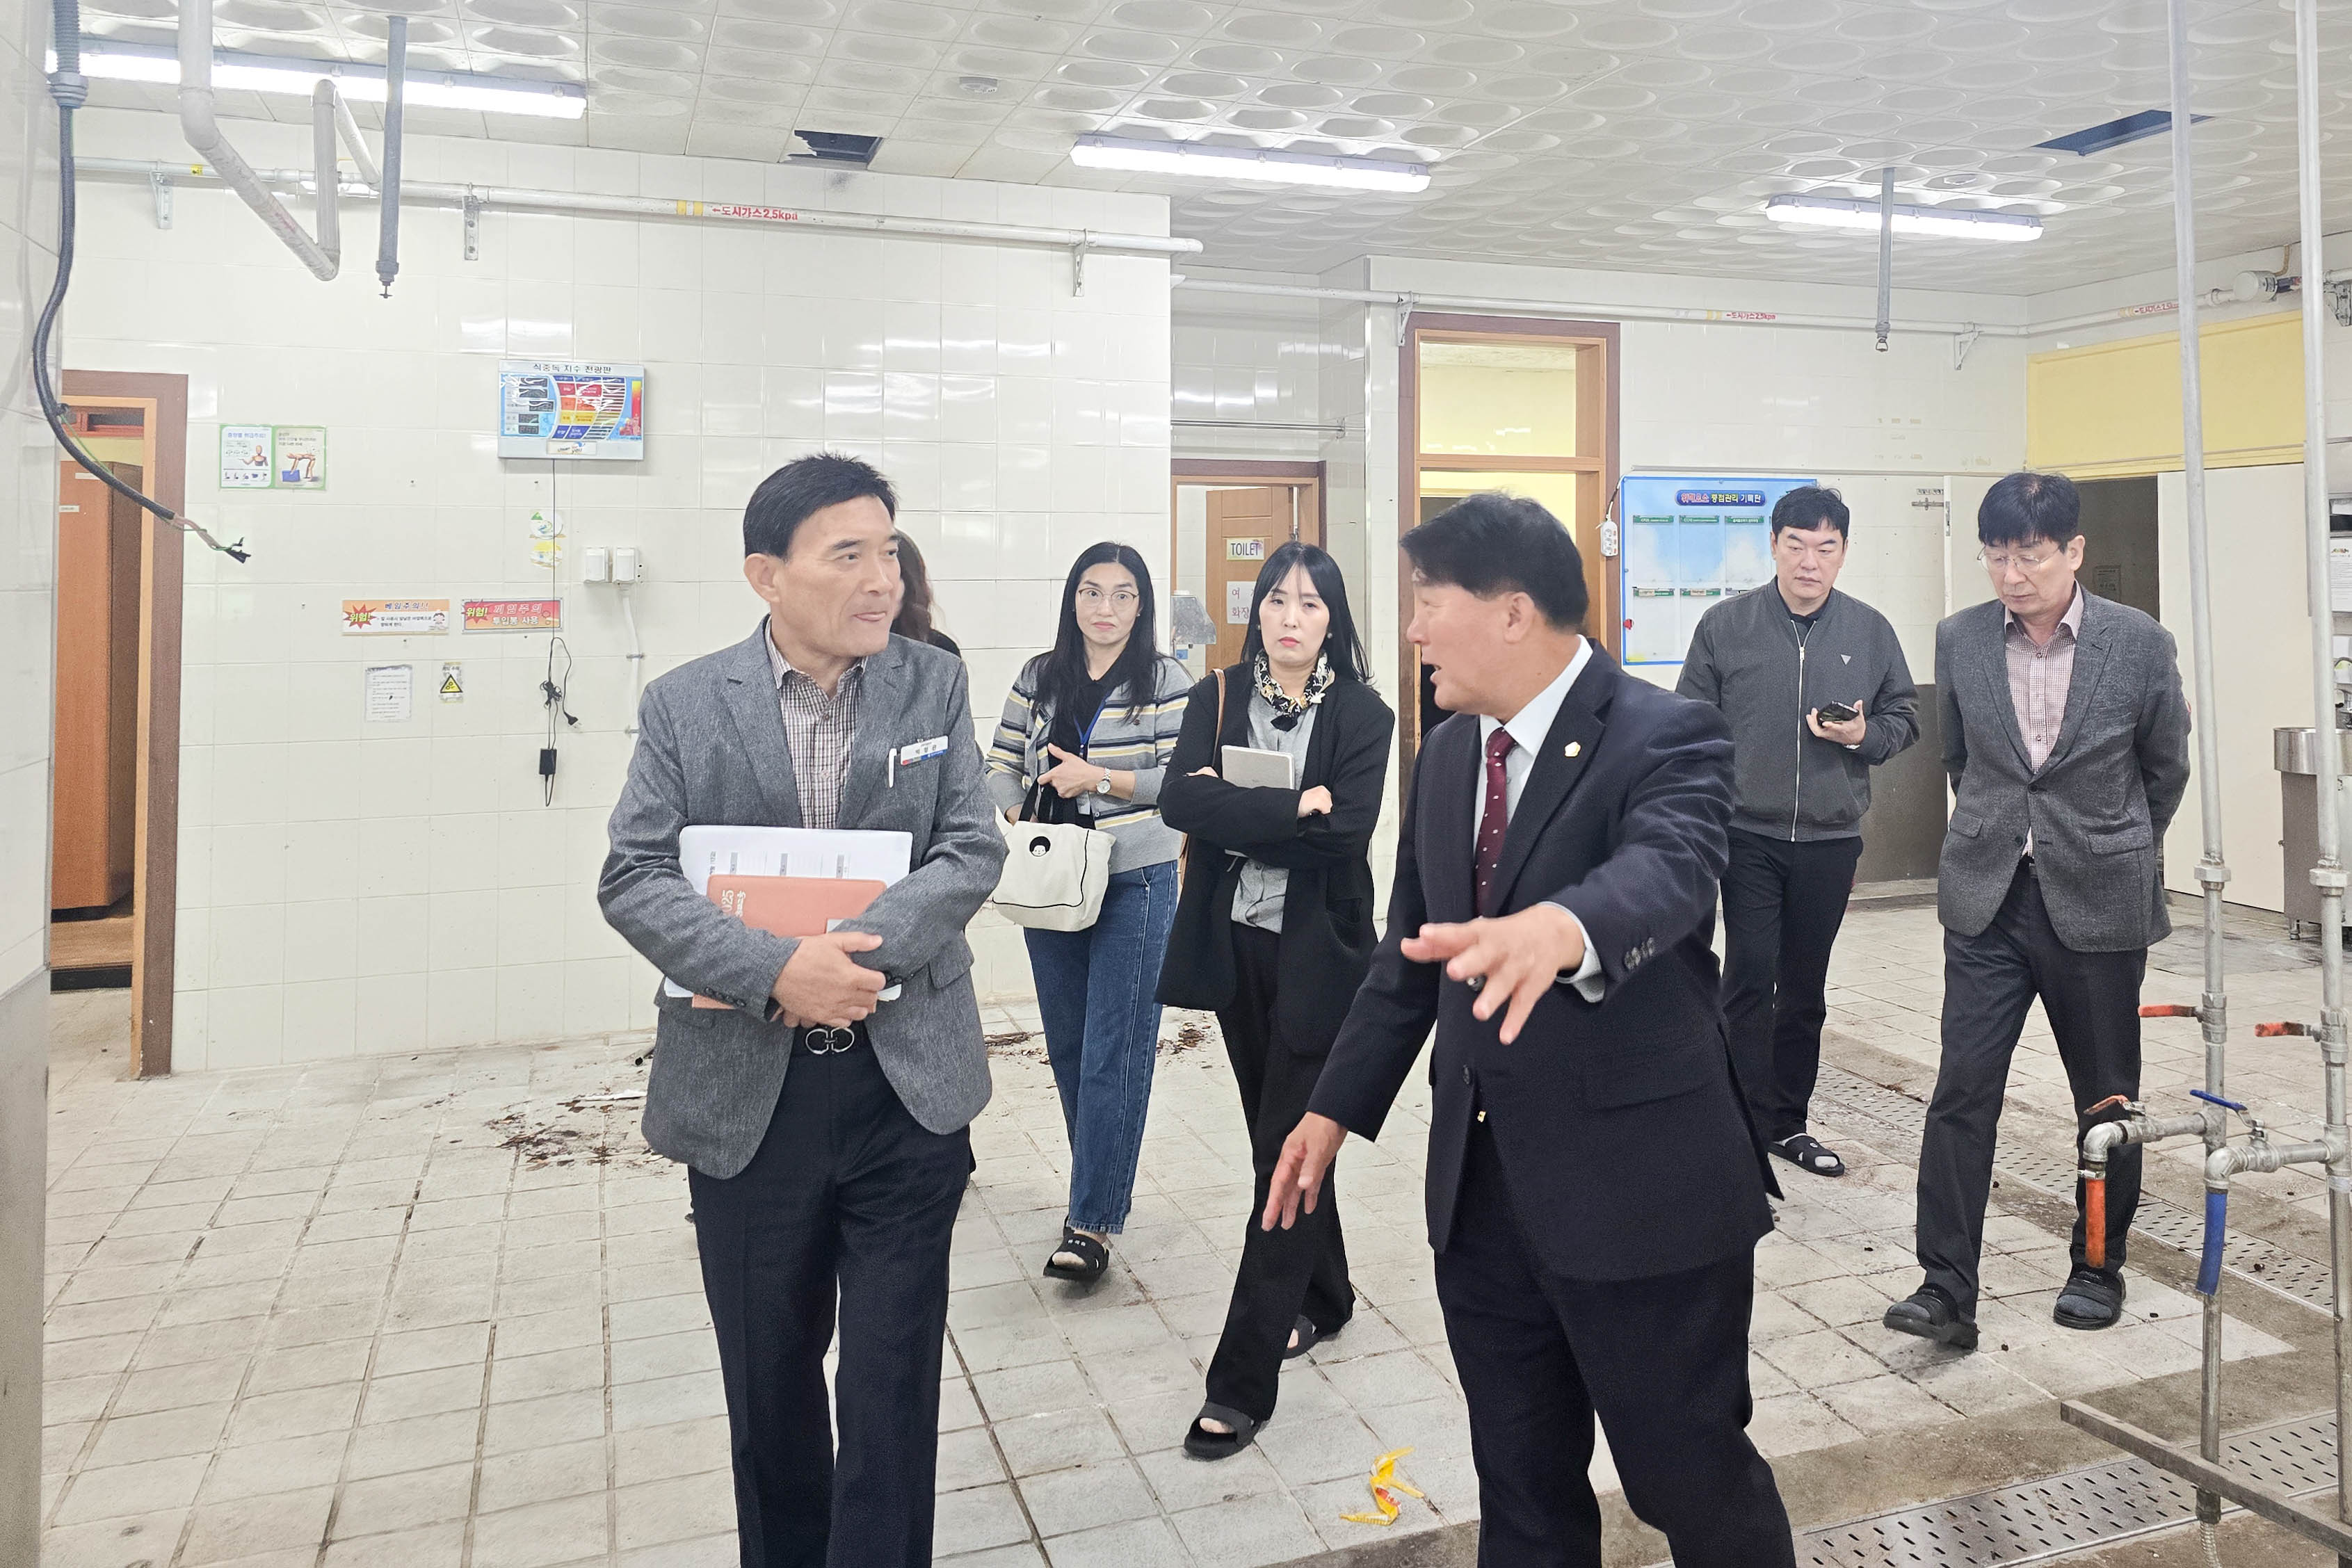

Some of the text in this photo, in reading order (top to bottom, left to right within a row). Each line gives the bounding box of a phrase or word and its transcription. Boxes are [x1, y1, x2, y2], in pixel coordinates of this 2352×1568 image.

[533, 363, 611, 374] 식중독 지수 전광판
[1230, 542, 1259, 556] TOILET
[1232, 587, 1240, 599] 여
[349, 611, 371, 622] 위험!
[467, 607, 488, 617] 위험!
[1232, 606, 1250, 619] 화장
[522, 616, 539, 624] 사용
